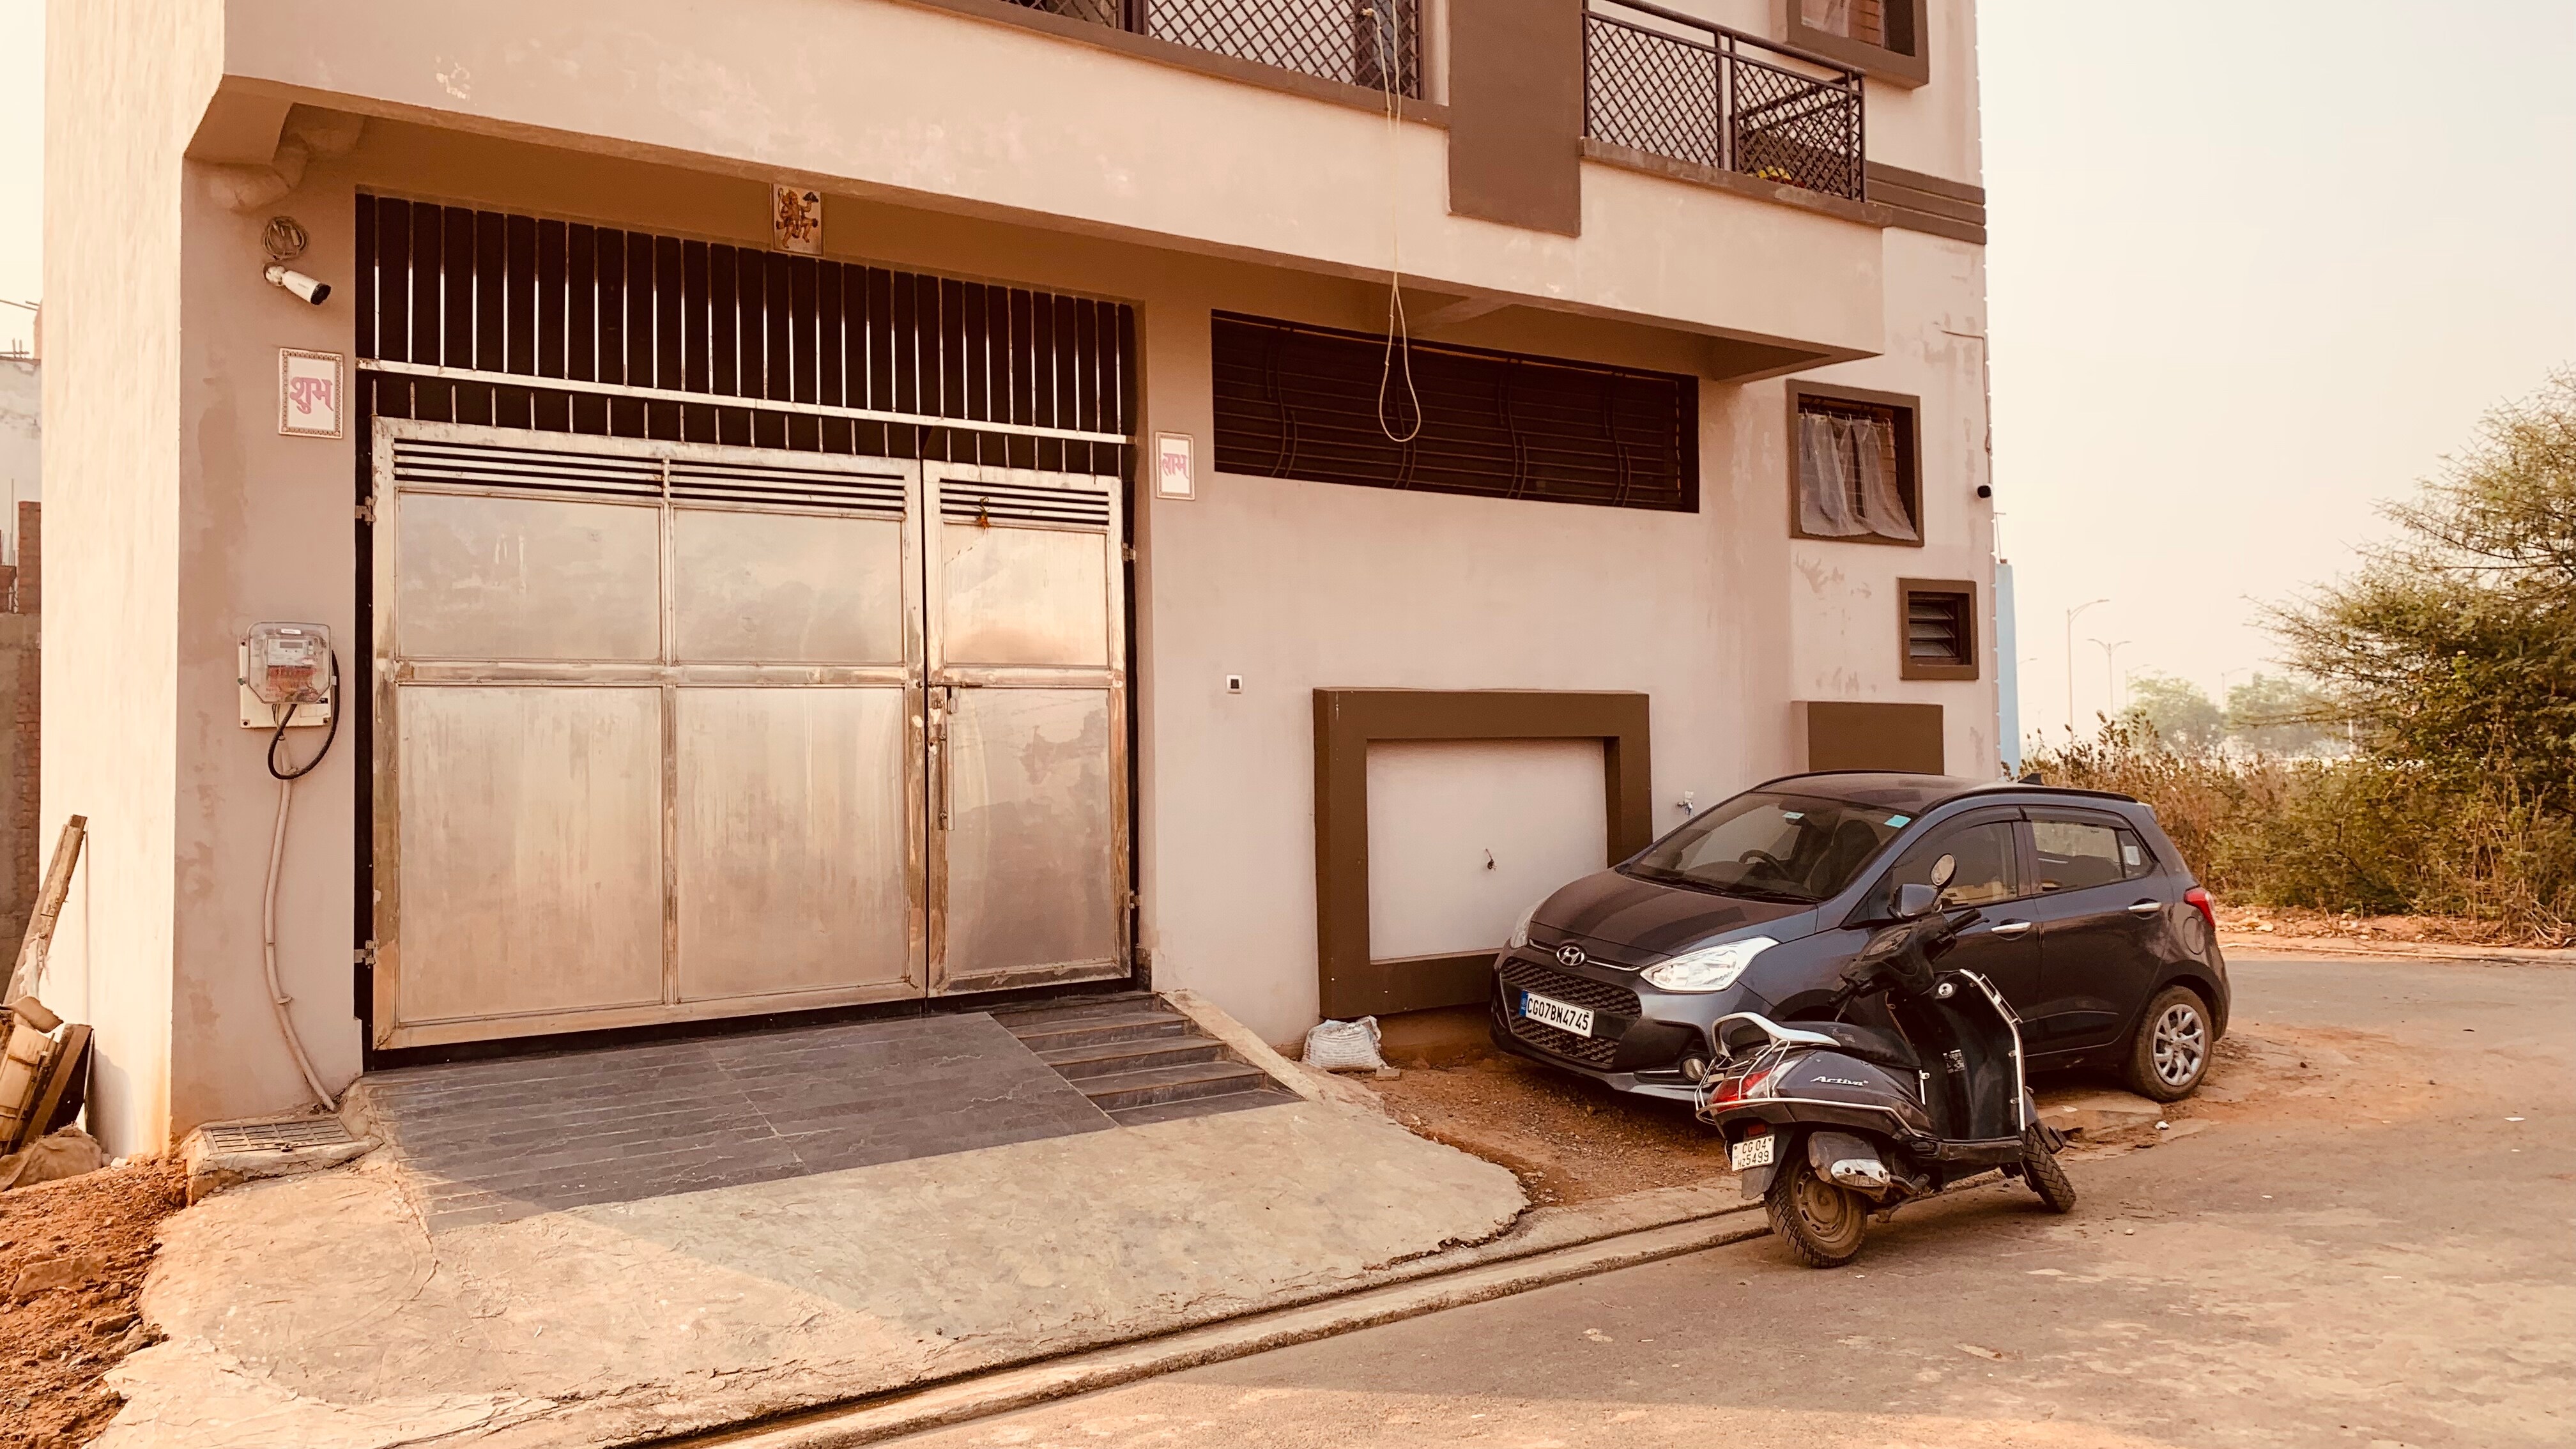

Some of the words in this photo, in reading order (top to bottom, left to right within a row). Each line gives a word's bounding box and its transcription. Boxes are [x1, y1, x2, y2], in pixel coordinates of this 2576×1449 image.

[289, 376, 334, 414] शुभ
[1162, 452, 1189, 480] लाभ
[1527, 998, 1590, 1031] CG07BN4745
[1810, 1076, 1864, 1087] Activa
[1742, 1141, 1753, 1154] CG
[1756, 1138, 1767, 1151] 04
